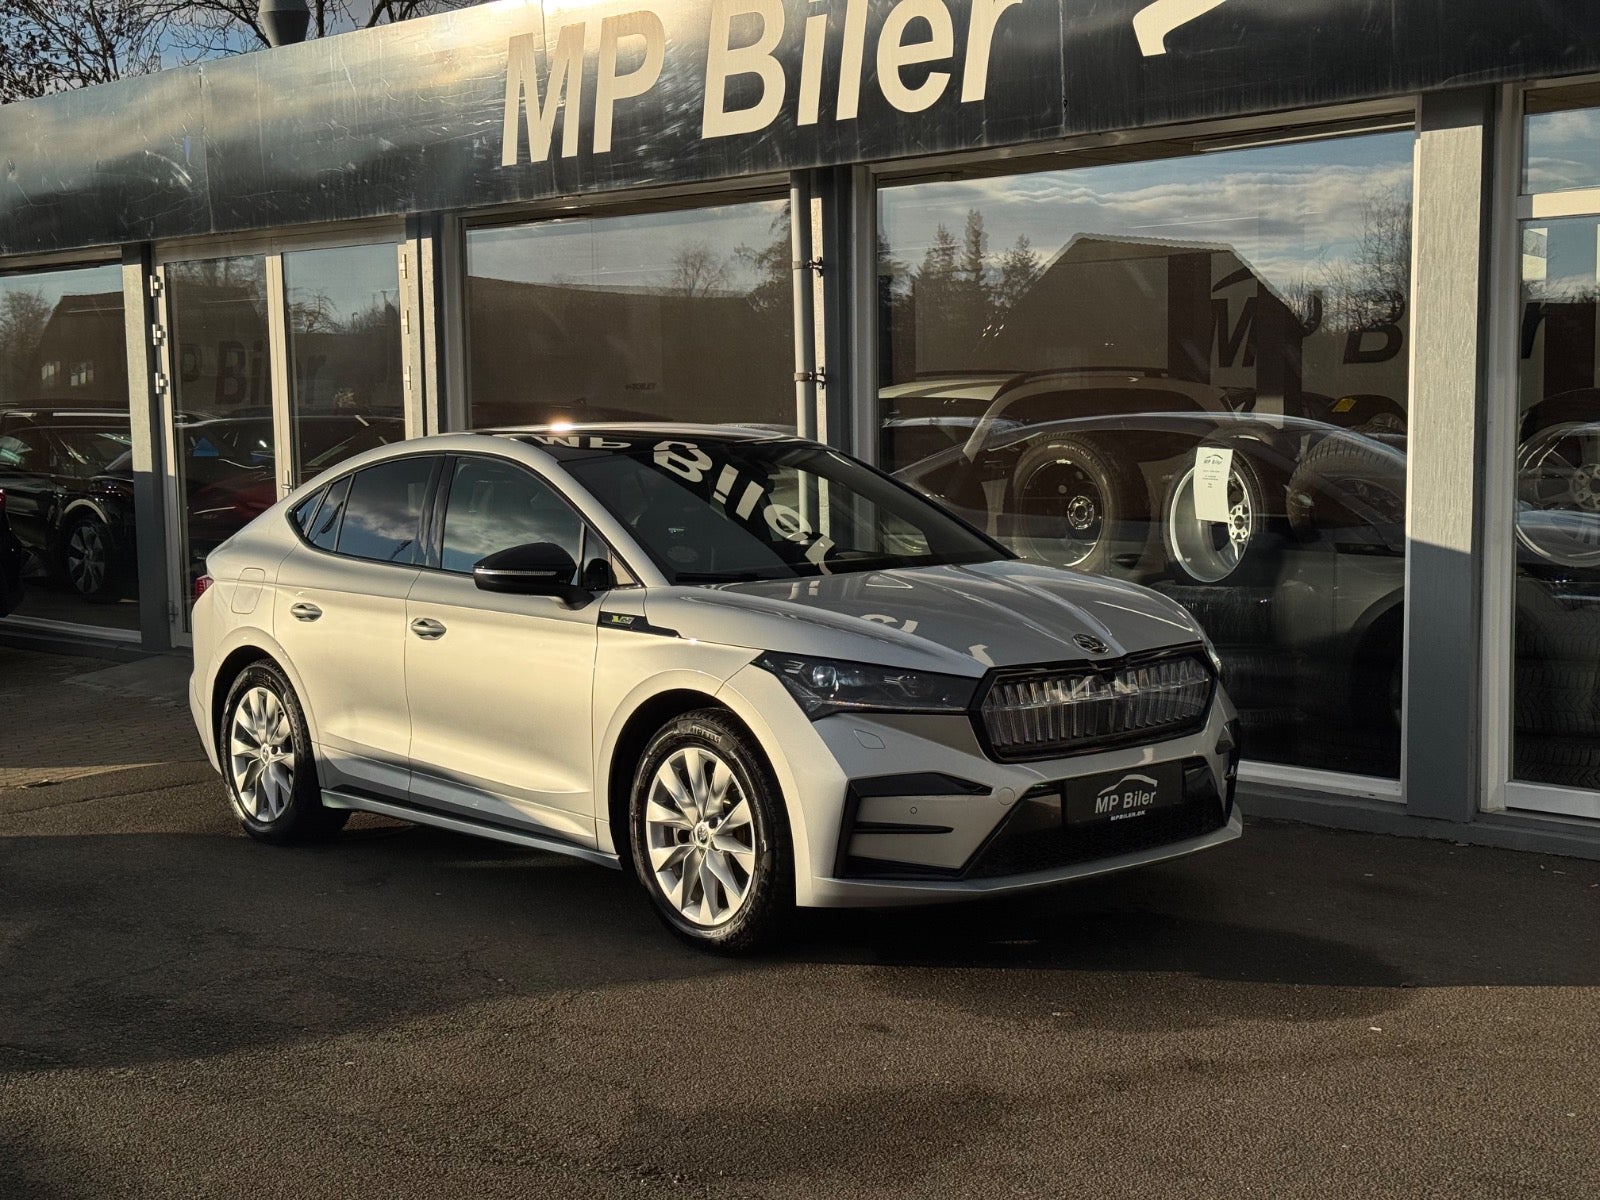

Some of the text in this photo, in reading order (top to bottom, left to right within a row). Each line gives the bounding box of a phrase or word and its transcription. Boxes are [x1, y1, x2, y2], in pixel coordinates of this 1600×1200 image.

[501, 0, 1022, 166] MP Biler
[1094, 789, 1157, 814] MP Biler
